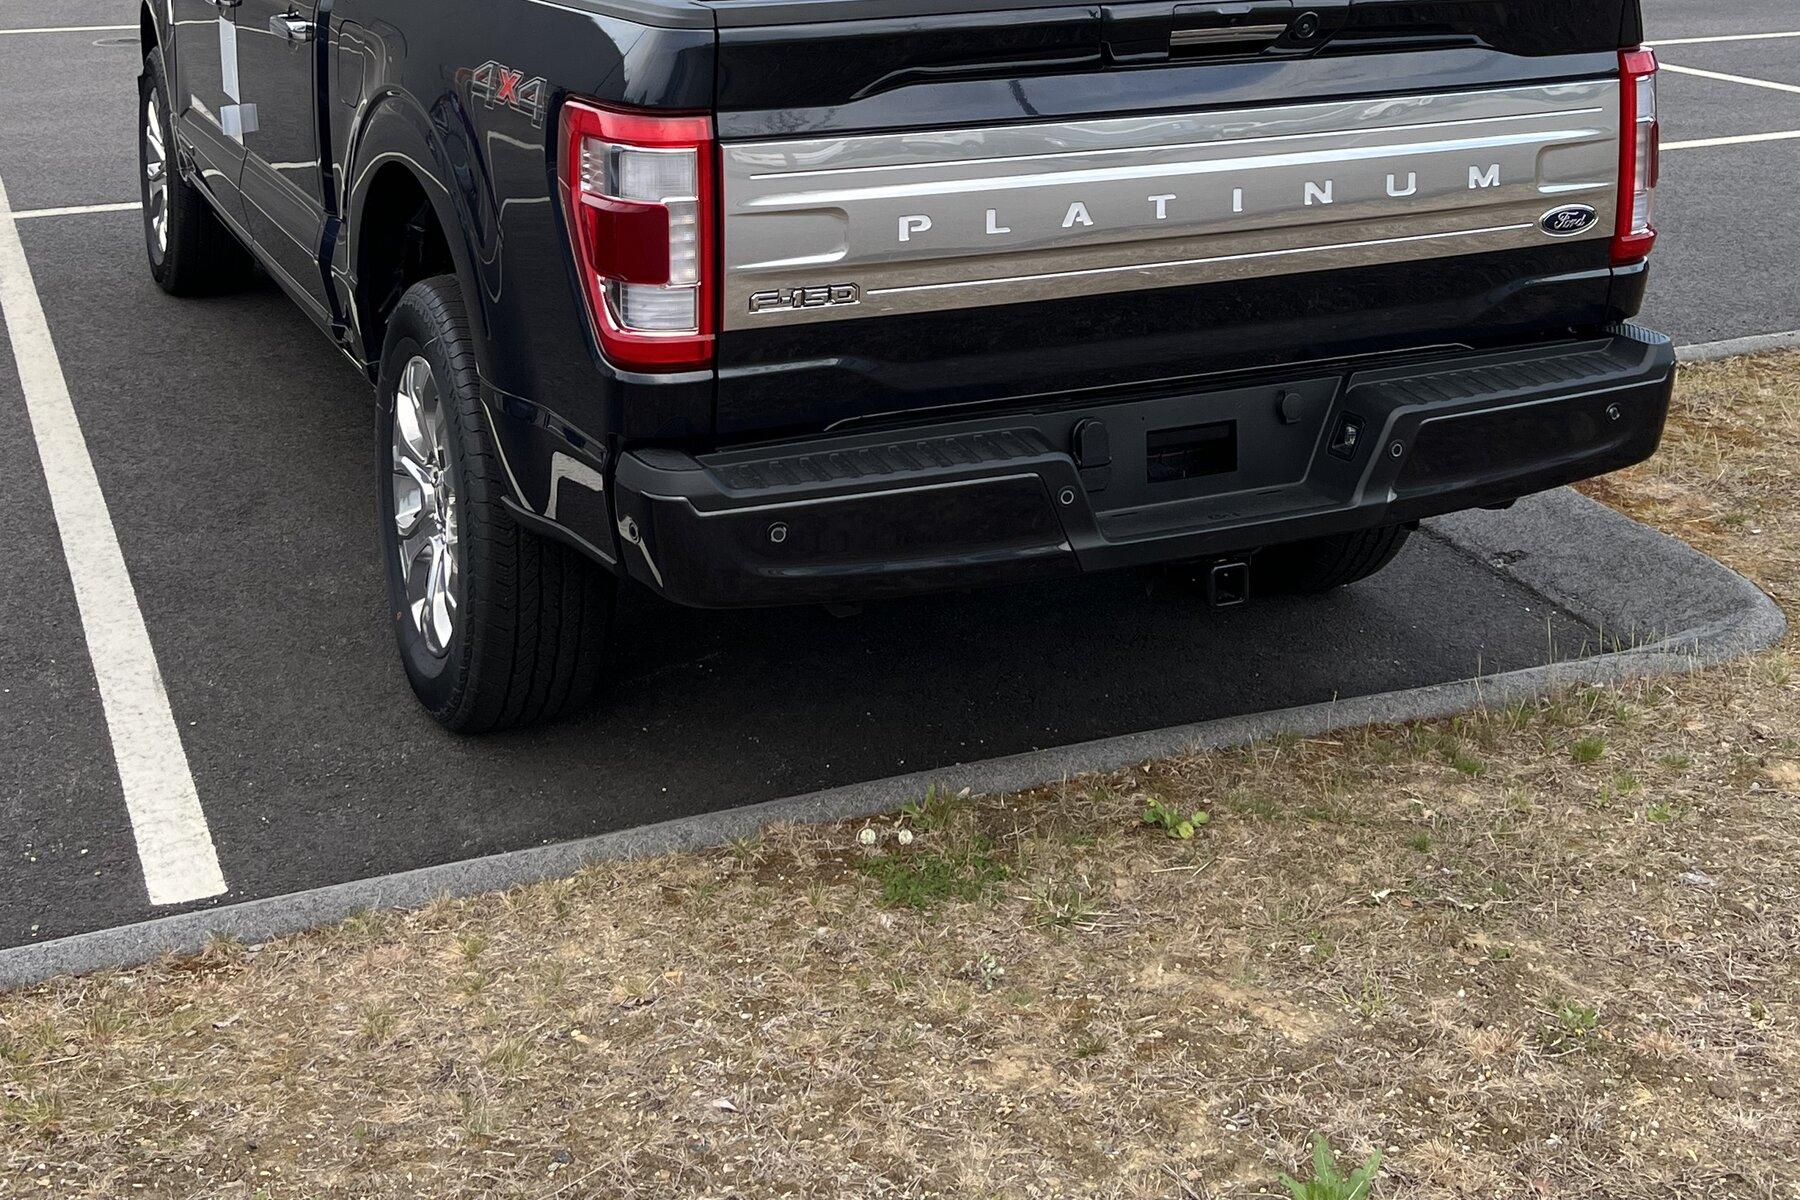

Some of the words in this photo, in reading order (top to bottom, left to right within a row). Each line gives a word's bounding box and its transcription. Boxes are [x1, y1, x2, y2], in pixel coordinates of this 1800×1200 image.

[898, 162, 1501, 242] PLATINUM
[1553, 211, 1587, 229] Ford
[748, 282, 861, 314] F-150
